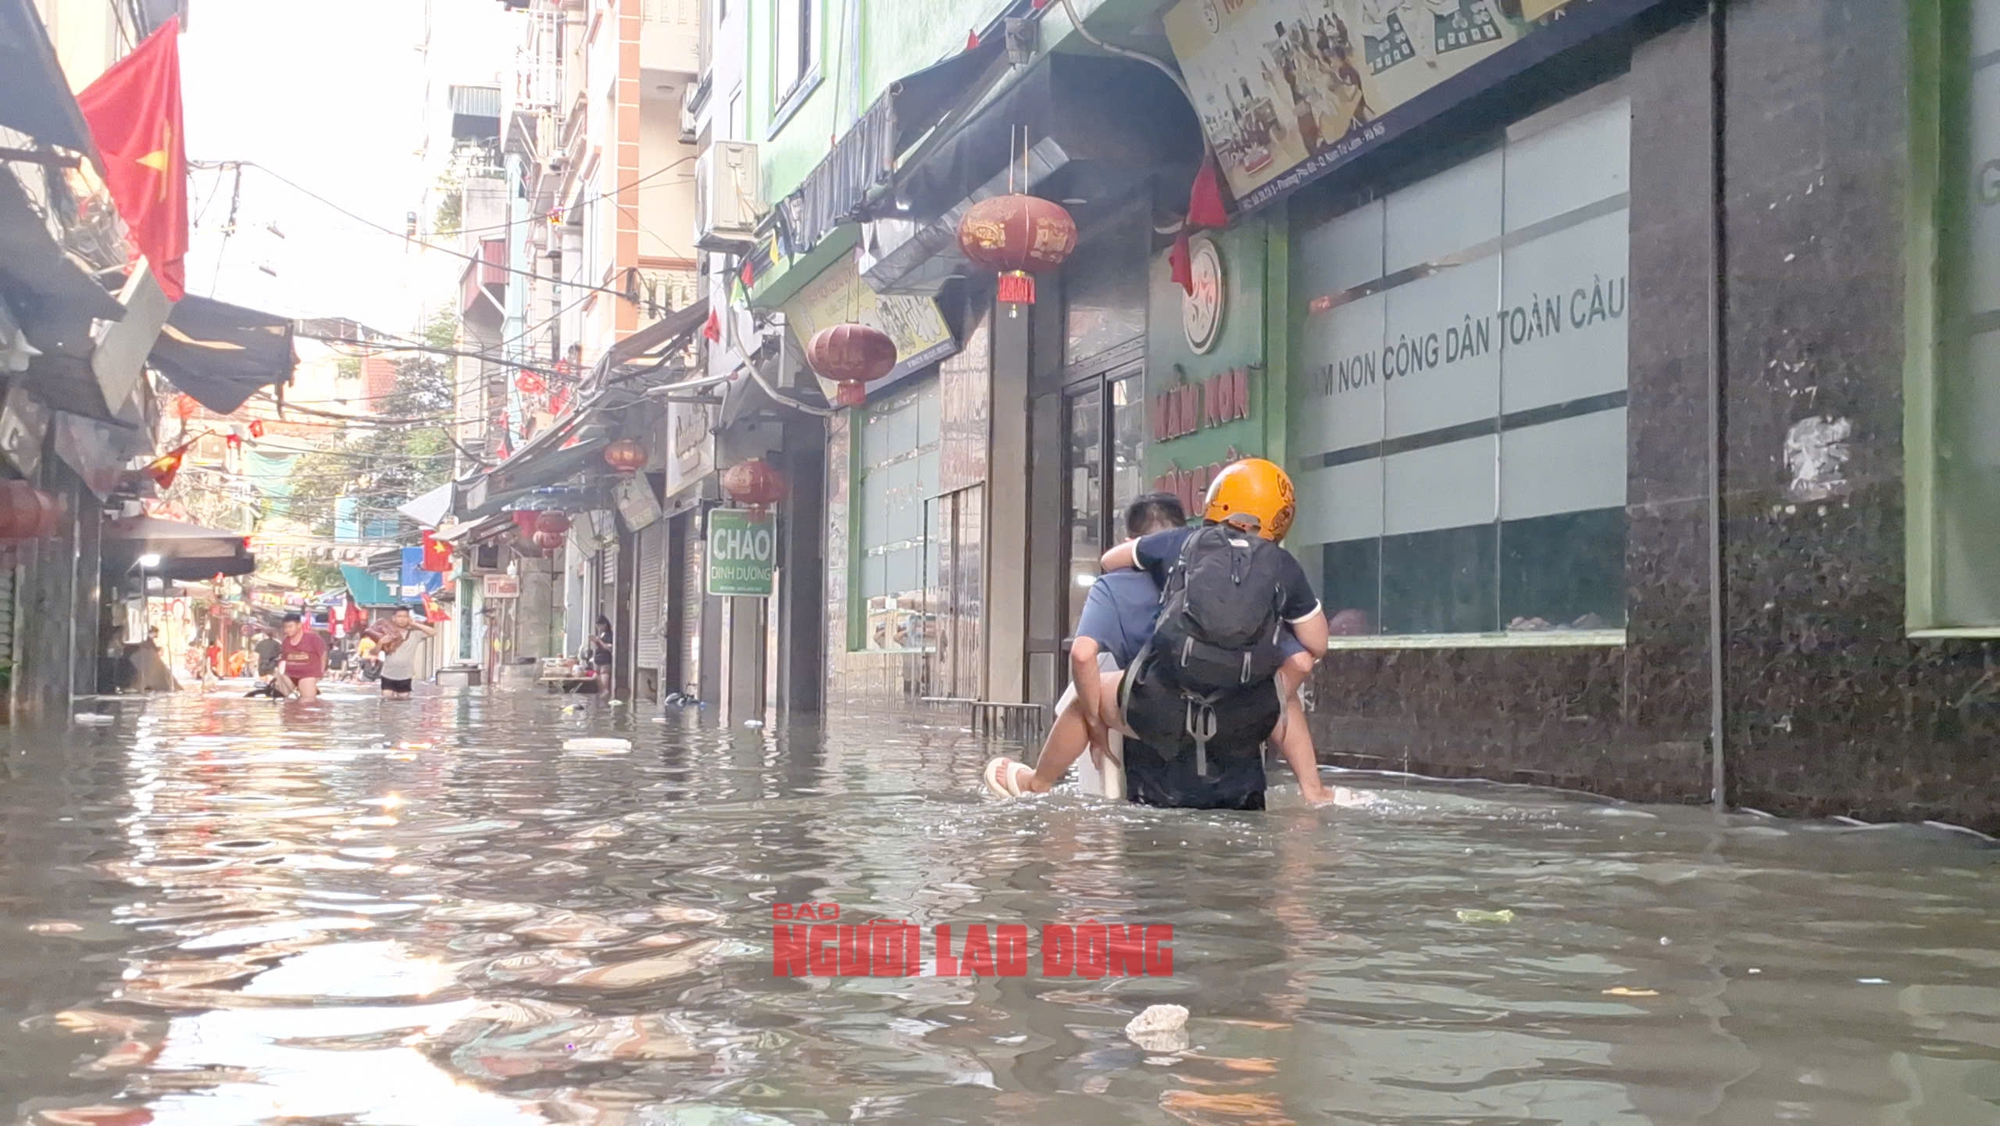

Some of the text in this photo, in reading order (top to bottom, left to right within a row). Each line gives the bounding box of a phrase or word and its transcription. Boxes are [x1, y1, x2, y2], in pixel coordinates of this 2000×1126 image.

[1338, 350, 1376, 394] NON
[1382, 332, 1439, 381] CÔNG
[1445, 313, 1490, 364] DÂN
[1497, 292, 1561, 349] TOÀN
[713, 521, 771, 561] CHÁO
